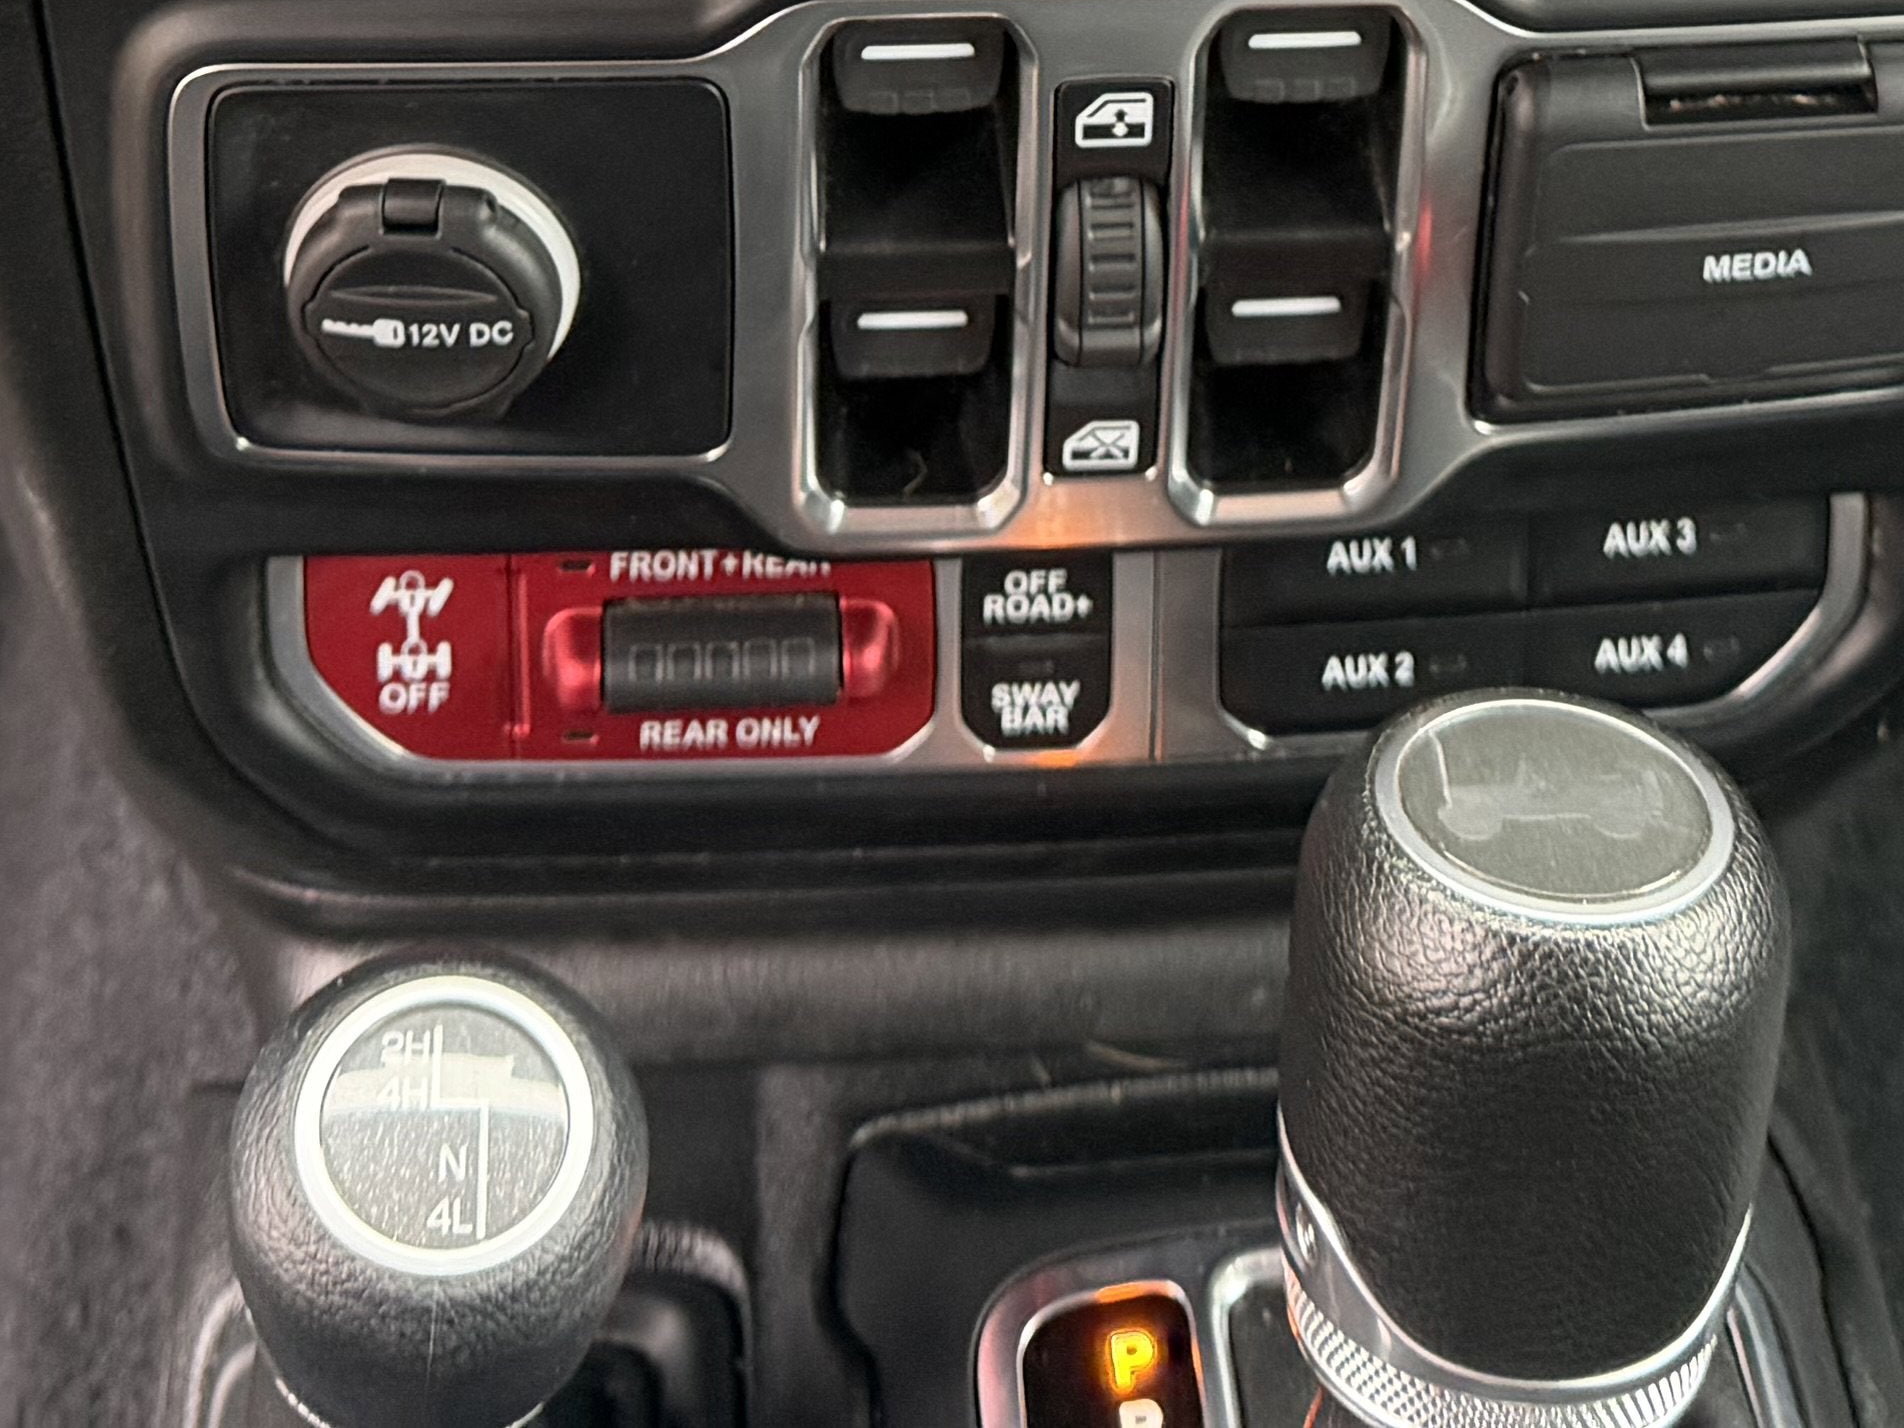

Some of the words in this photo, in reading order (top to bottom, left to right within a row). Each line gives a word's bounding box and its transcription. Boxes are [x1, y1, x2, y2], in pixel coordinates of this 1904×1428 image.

[1702, 248, 1813, 283] MEDIA
[408, 324, 461, 347] 12V
[469, 321, 514, 345] DC
[1326, 537, 1395, 575] AUX
[1401, 535, 1418, 571] 1
[1602, 519, 1672, 559] AUX
[1676, 516, 1697, 556] 3
[1004, 568, 1068, 594] OFF
[983, 594, 1094, 625] ROAD+
[1321, 652, 1390, 692] AUX
[1395, 650, 1415, 688] 2
[1594, 634, 1664, 675] AUX
[1666, 632, 1689, 669] 4
[379, 682, 451, 713] OFF
[991, 679, 1081, 712] SWAY
[639, 718, 729, 752] REAR
[735, 715, 820, 748] ONLY
[1001, 706, 1069, 737] BAR
[438, 1142, 468, 1184] N
[426, 1195, 473, 1236] 4L
[1110, 1330, 1155, 1390] P
